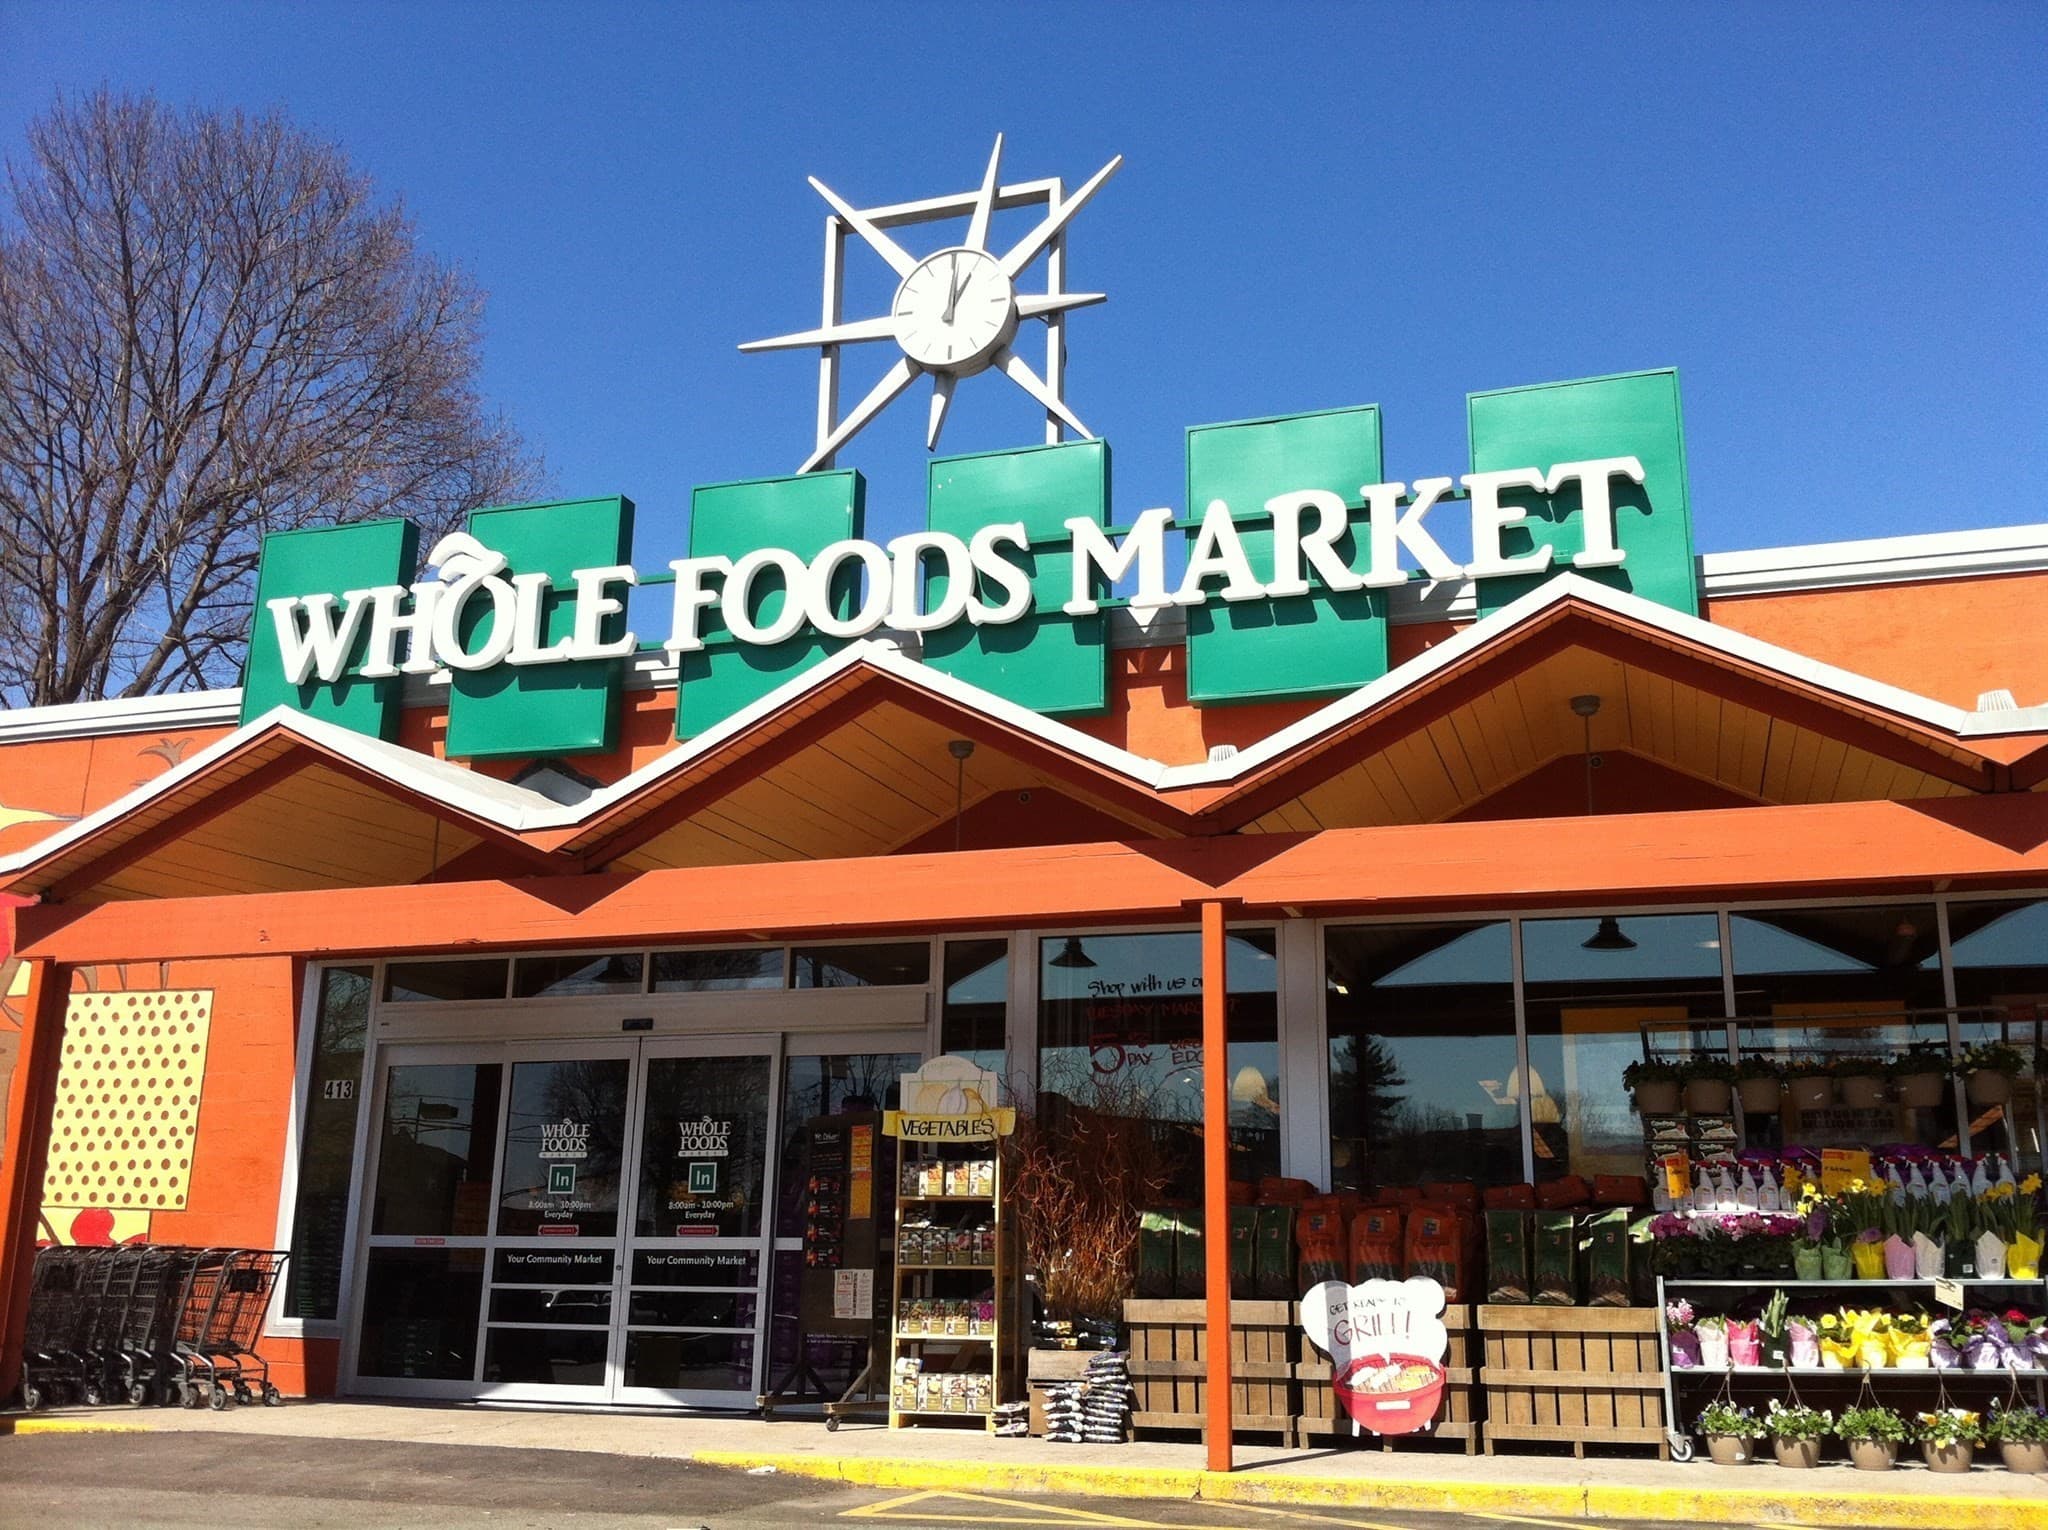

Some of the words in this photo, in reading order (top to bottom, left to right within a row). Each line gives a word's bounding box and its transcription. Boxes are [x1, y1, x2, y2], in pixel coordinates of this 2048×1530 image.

[267, 532, 638, 685] WHOLE
[663, 521, 1033, 651] FOODS
[1063, 456, 1646, 616] MARKET
[1088, 979, 1125, 998] Shop
[1131, 973, 1162, 994] with
[1167, 977, 1186, 991] us
[1162, 999, 1203, 1016] MARC
[1128, 1052, 1153, 1066] DAY
[325, 1081, 352, 1098] 413
[541, 1118, 591, 1138] WHOLE
[679, 1115, 731, 1135] WHOLE
[900, 1118, 995, 1137] VEGETABLES
[541, 1138, 587, 1151] FOODS
[680, 1136, 728, 1150] FOODS
[555, 1171, 570, 1187] In
[696, 1170, 711, 1185] In
[544, 1210, 573, 1220] Everyday
[685, 1210, 715, 1219] Everyday
[507, 1254, 525, 1264] Your
[527, 1254, 572, 1265] Community
[574, 1254, 602, 1264] Market
[647, 1255, 665, 1265] Your
[667, 1255, 715, 1267] Community
[717, 1255, 746, 1265] Market
[1329, 1301, 1349, 1316] GET
